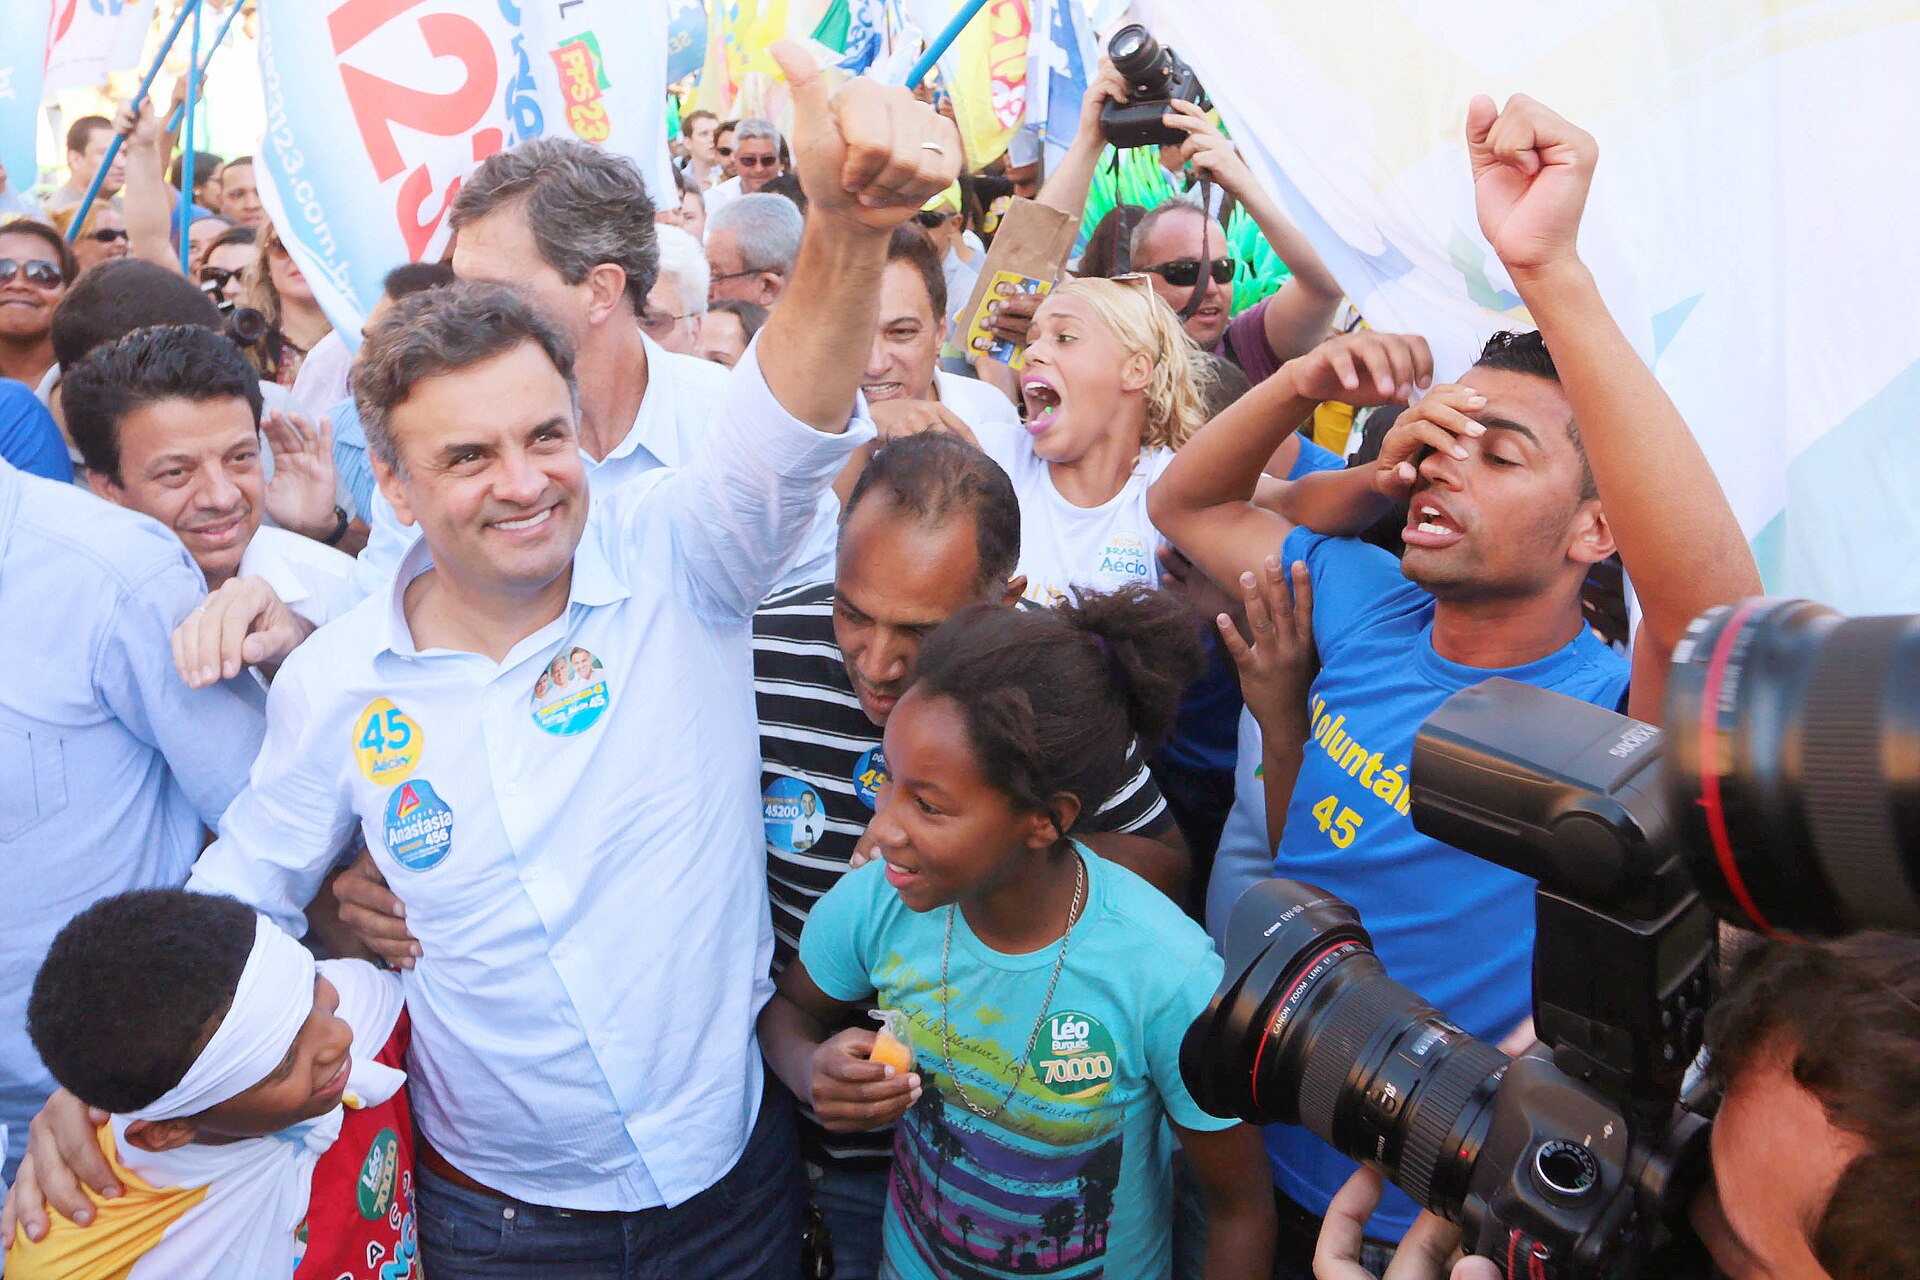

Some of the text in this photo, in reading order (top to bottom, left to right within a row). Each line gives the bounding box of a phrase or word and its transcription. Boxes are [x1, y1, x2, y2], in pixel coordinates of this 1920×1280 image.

[1100, 556, 1147, 576] Aécio
[359, 708, 411, 754] 45
[389, 810, 453, 847] Anastasia
[765, 804, 799, 818] 45200
[1312, 795, 1364, 848] 45
[1273, 1005, 1291, 1035] CANON
[1290, 981, 1309, 1004] ZOOM
[1051, 1015, 1090, 1041] Léo
